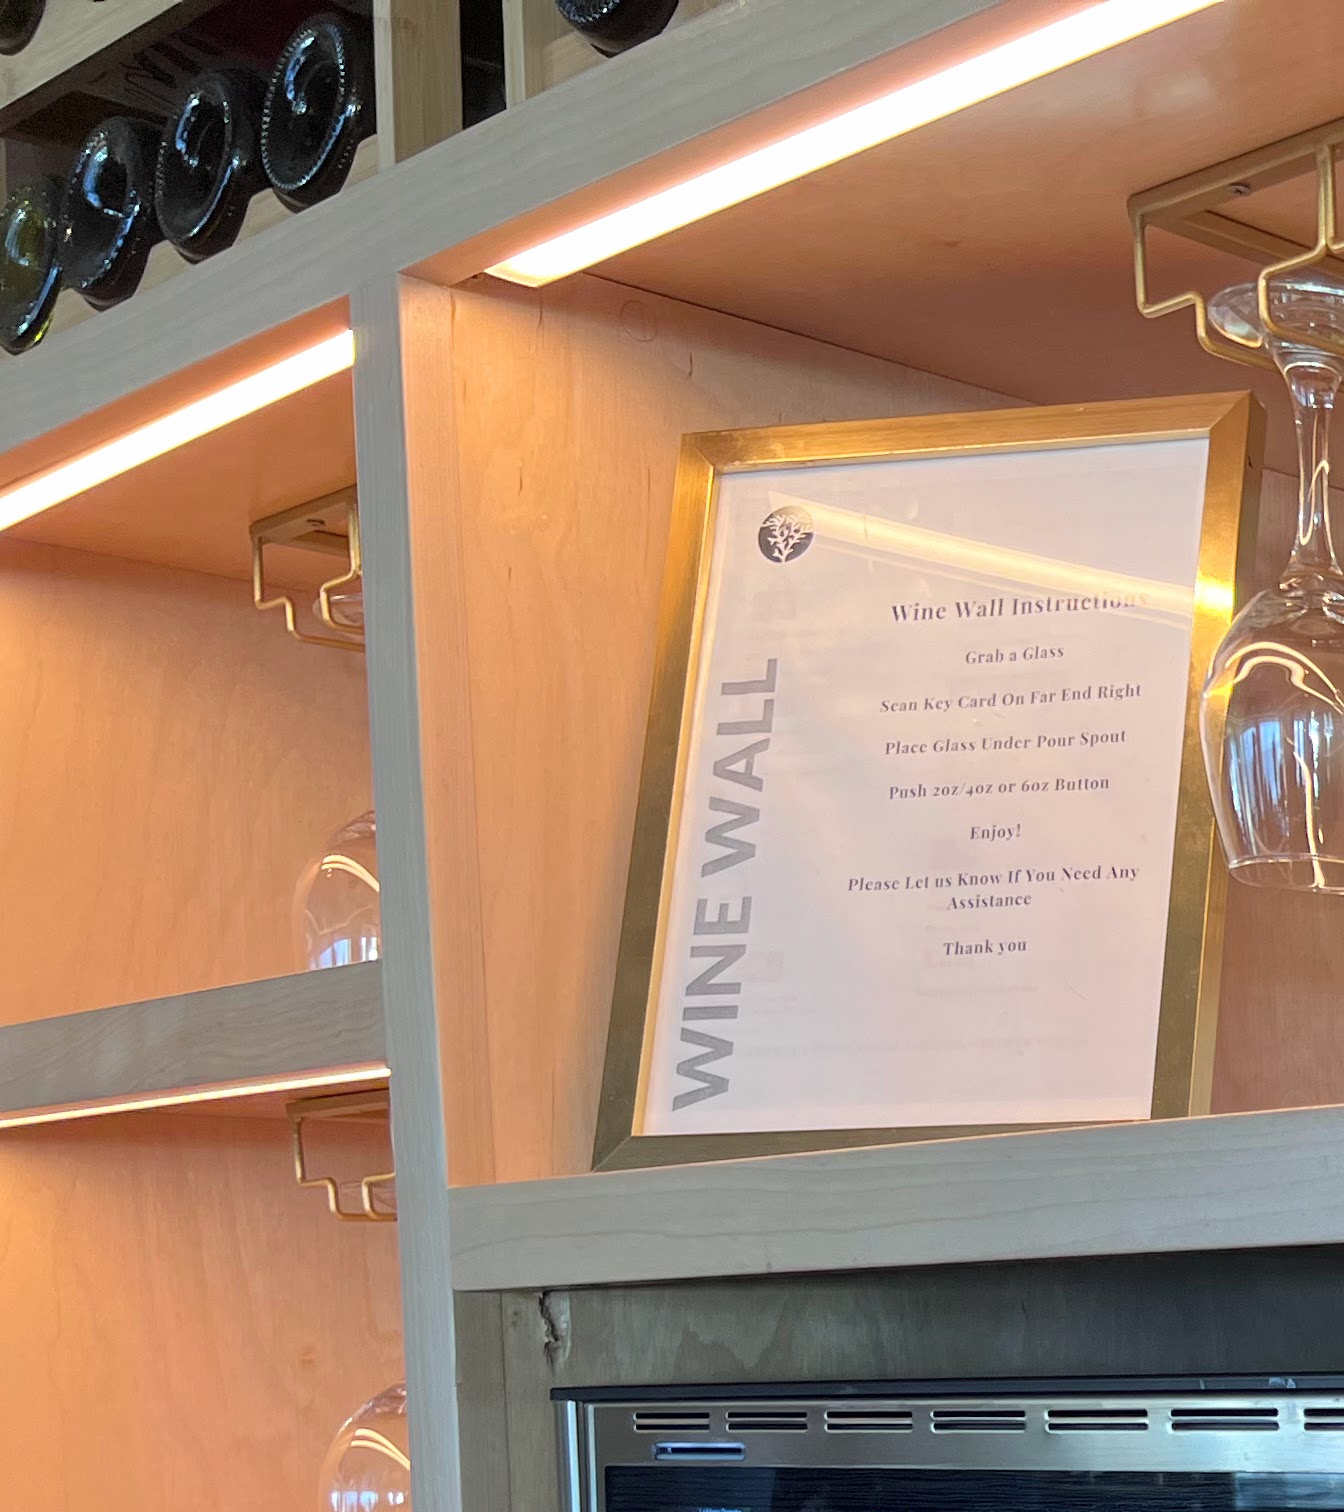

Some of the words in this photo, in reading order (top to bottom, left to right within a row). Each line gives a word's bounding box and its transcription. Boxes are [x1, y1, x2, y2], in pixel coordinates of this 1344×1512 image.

[892, 603, 946, 622] Wine
[956, 598, 1003, 618] Wall
[965, 650, 1004, 664] Grab
[1009, 652, 1017, 661] a
[1023, 646, 1064, 660] Glass
[880, 699, 918, 713] Scan
[924, 698, 951, 712] Key
[958, 694, 997, 708] Card
[1002, 693, 1024, 706] On
[1030, 691, 1056, 704] Far
[1062, 686, 1092, 701] End
[1098, 684, 1141, 701] Right
[885, 742, 928, 754] Place
[933, 739, 976, 752] Glass
[982, 736, 1031, 751] Under
[1037, 734, 1075, 748] Pour
[1080, 730, 1126, 747] Spout
[701, 658, 777, 878] WALL
[889, 785, 927, 799] Push
[998, 782, 1016, 793] or
[1021, 780, 1049, 791] 6oz
[1055, 777, 1109, 790] Button
[970, 824, 1021, 842] Enjoy!
[848, 878, 900, 891] Please
[905, 876, 929, 890] Let
[935, 876, 952, 888] us
[958, 872, 1001, 886] Know
[1008, 870, 1023, 884] If
[1026, 869, 1055, 882] You
[1062, 866, 1101, 880] Need
[1107, 866, 1140, 882] Any
[947, 894, 1032, 910] Assistance
[944, 940, 994, 955] Thank
[998, 941, 1027, 955] you
[672, 896, 752, 1112] WINE
